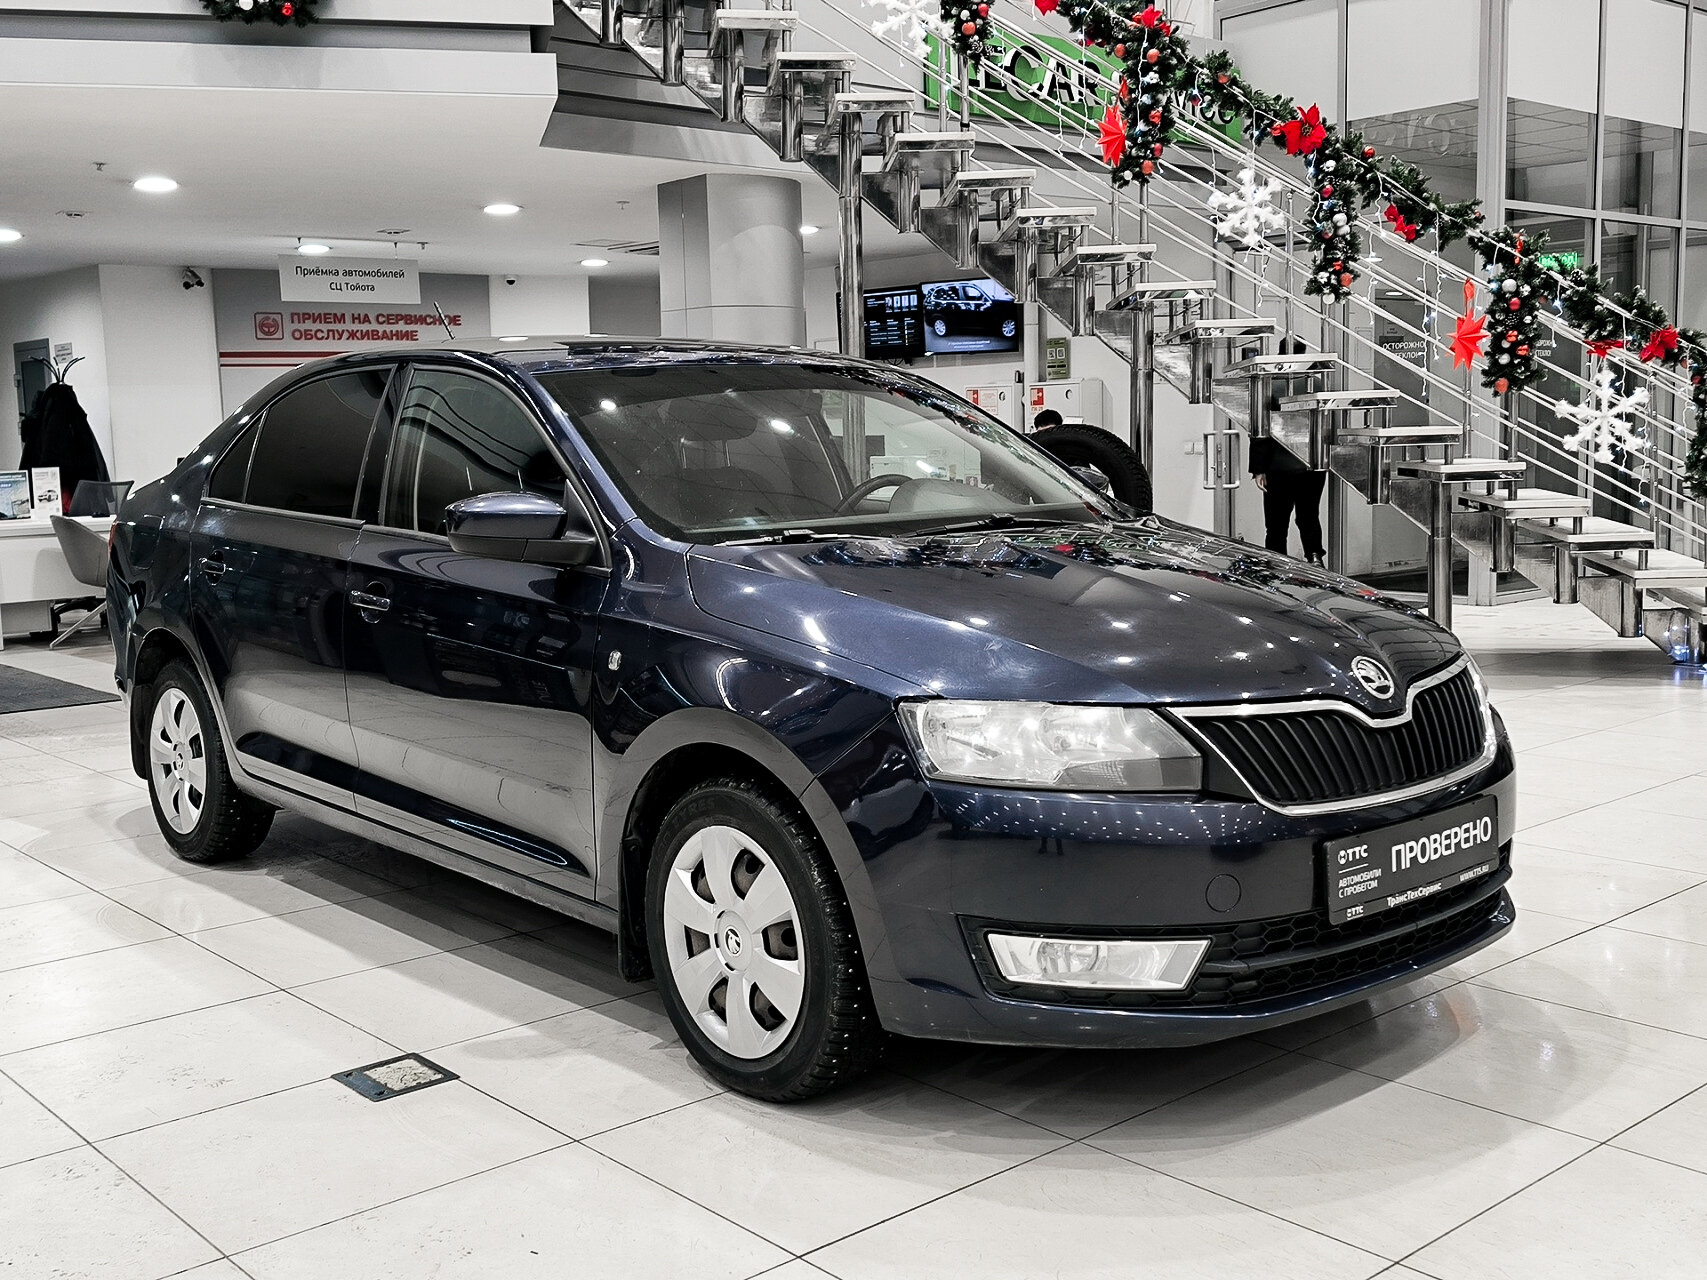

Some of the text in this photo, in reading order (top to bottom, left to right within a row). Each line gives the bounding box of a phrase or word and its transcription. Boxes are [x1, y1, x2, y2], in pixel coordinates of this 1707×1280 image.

[295, 266, 405, 279] Приёмка автомобилей
[329, 282, 375, 292] СЦ Тойота
[291, 312, 462, 326] ПРИЕМ НА СЕРВИСНОЕ
[291, 328, 419, 341] ОБСЛУЖИВАНИЕ
[1383, 341, 1425, 350] ОСТОРОЖНО
[1391, 816, 1492, 873] ПРОВЕРЕНО
[1338, 868, 1382, 888] АВТОМОБИЛИ
[1338, 879, 1378, 899] С ПРОБЕГОМ
[1386, 882, 1442, 908] ТрансТехСервис
